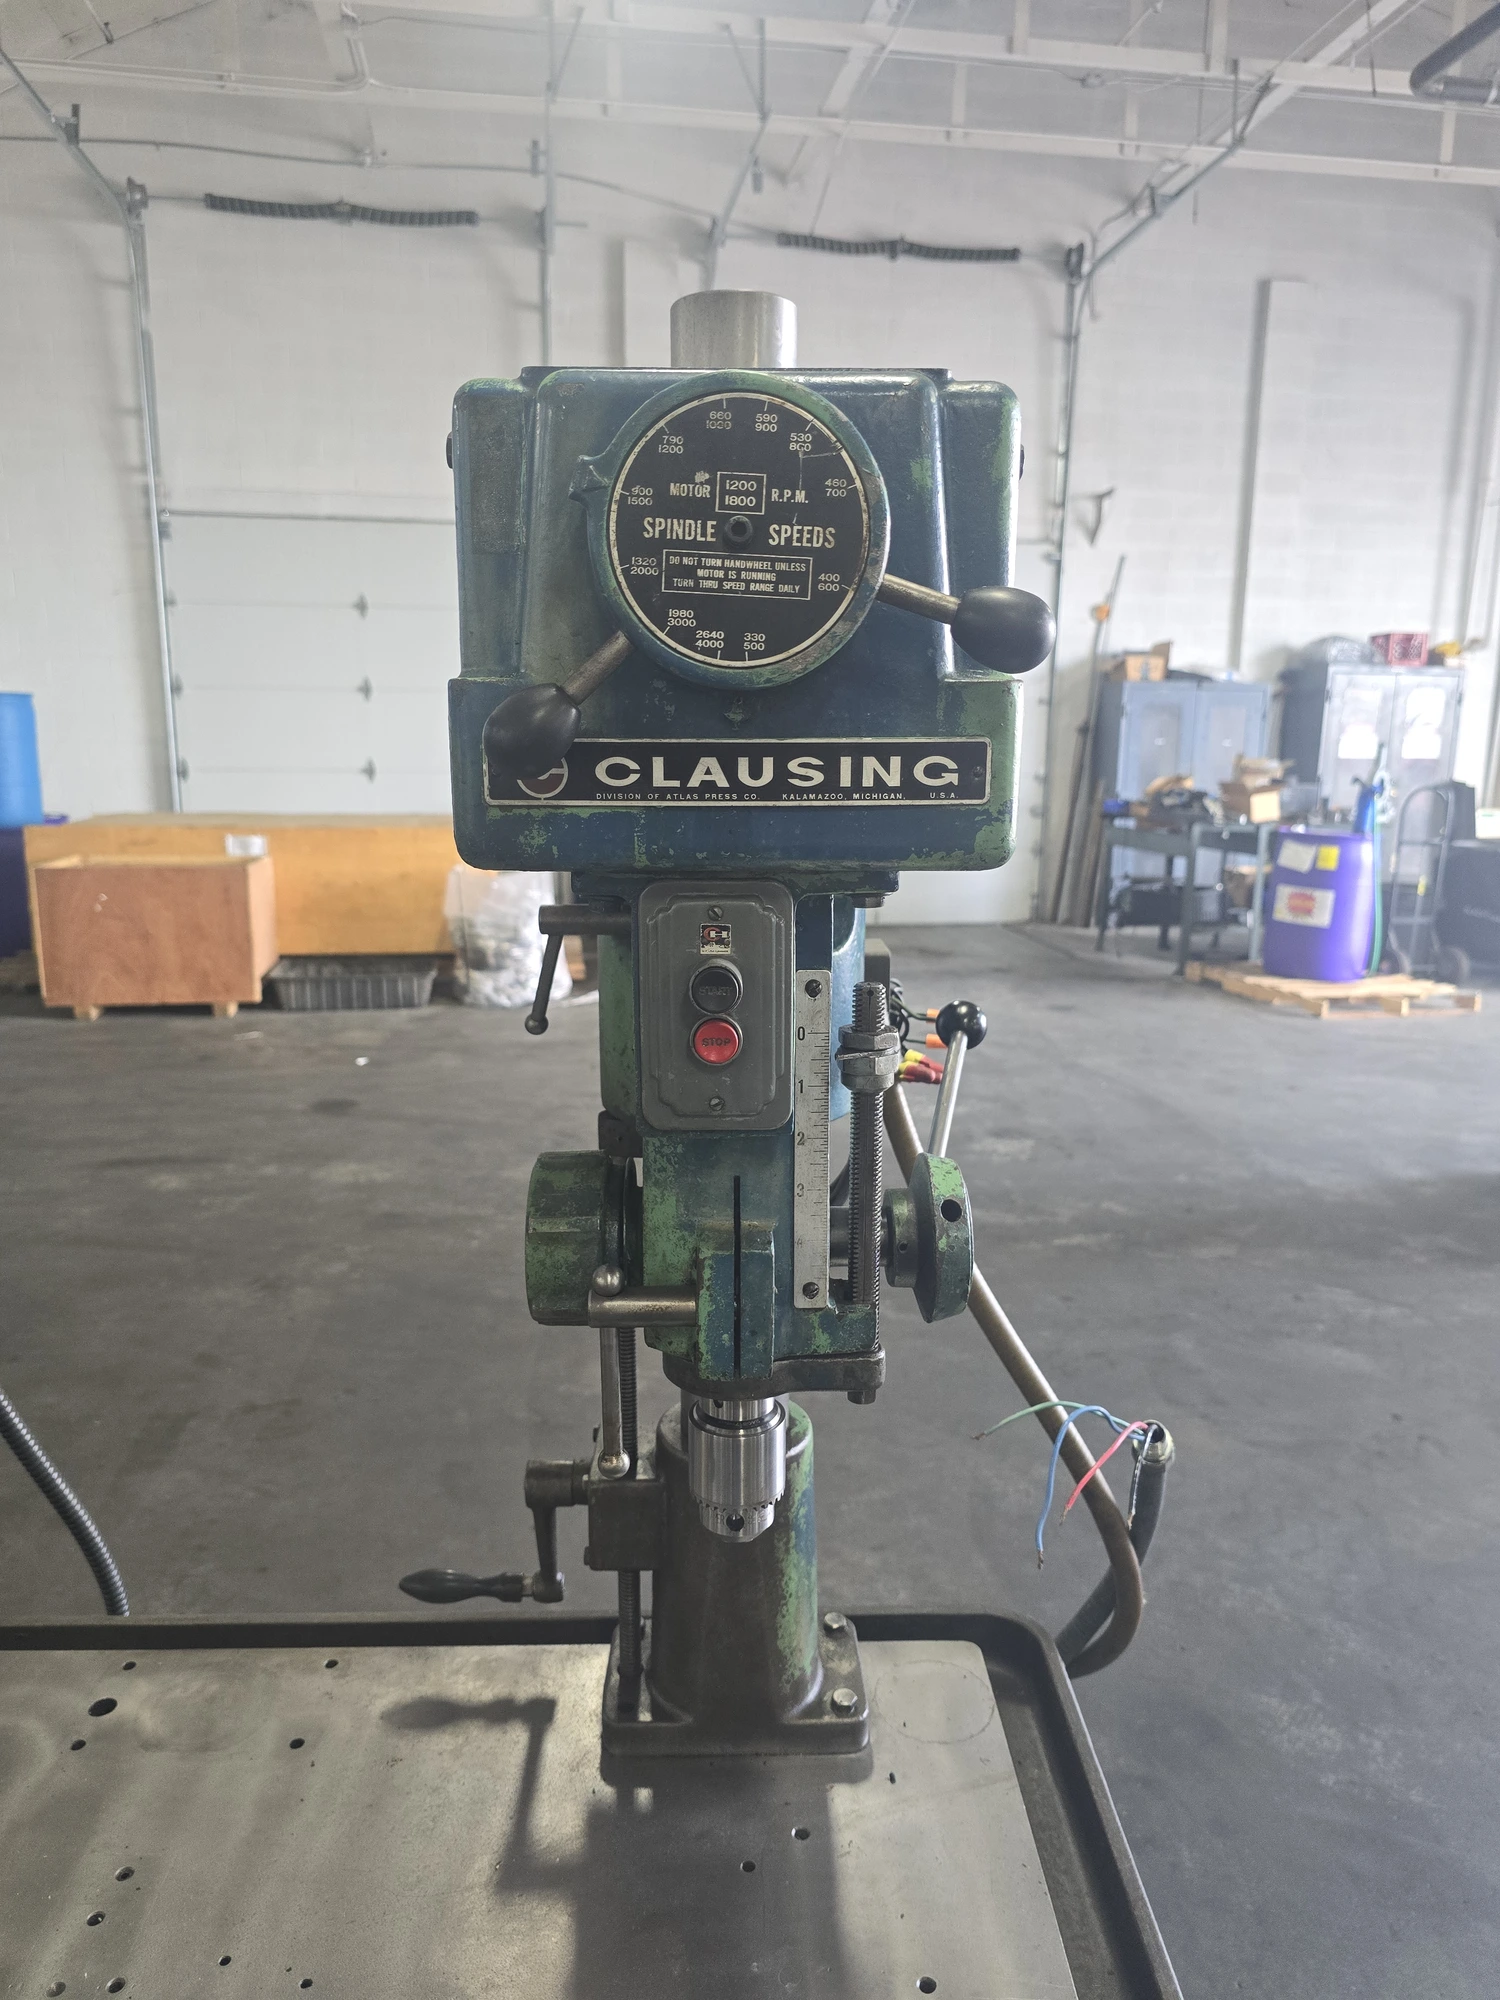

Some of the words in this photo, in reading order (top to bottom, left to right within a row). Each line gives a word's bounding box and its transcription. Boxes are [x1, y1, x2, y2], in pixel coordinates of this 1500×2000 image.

[709, 411, 732, 420] 660
[755, 413, 778, 423] 590
[755, 423, 778, 432] 900
[662, 435, 684, 445] 790
[789, 433, 812, 442] 530
[658, 444, 684, 454] 1200
[725, 480, 757, 492] 1200
[824, 478, 847, 488] 460
[631, 487, 653, 496] 900
[669, 482, 711, 498] MOTOR
[825, 488, 847, 498] 700
[627, 496, 653, 506] 1500
[724, 495, 756, 507] 1800
[771, 488, 809, 504] R.P.M.
[643, 517, 717, 542] SPINDLE
[768, 523, 836, 549] SPEEDS
[631, 556, 657, 566] 1320
[669, 556, 680, 565] DO
[682, 556, 698, 566] NOT
[701, 557, 723, 567] TURN
[724, 559, 773, 570] HANDWHEEL
[775, 562, 807, 572] UNLESS
[630, 566, 659, 576] 2000
[697, 568, 725, 578] MOTOR
[728, 570, 737, 579] IS
[741, 571, 777, 581] RUNNING
[818, 573, 840, 582] 400
[673, 578, 694, 588] TURN
[698, 579, 719, 589] THRU
[722, 581, 746, 591] SPEED
[750, 582, 775, 592] RANGE
[778, 584, 800, 594] DAILY
[817, 582, 840, 592] 600
[668, 608, 694, 618] 1980
[667, 617, 697, 627] 3000
[695, 630, 725, 640] 2640
[743, 632, 766, 642] 330
[695, 639, 724, 649] 4000
[743, 641, 765, 651] 500
[594, 755, 959, 788] CLAUSING
[797, 1026, 806, 1041] 0
[702, 1037, 731, 1047] STOP
[797, 1079, 804, 1094] 1
[796, 1131, 805, 1146] 2
[796, 1182, 805, 1198] 3
